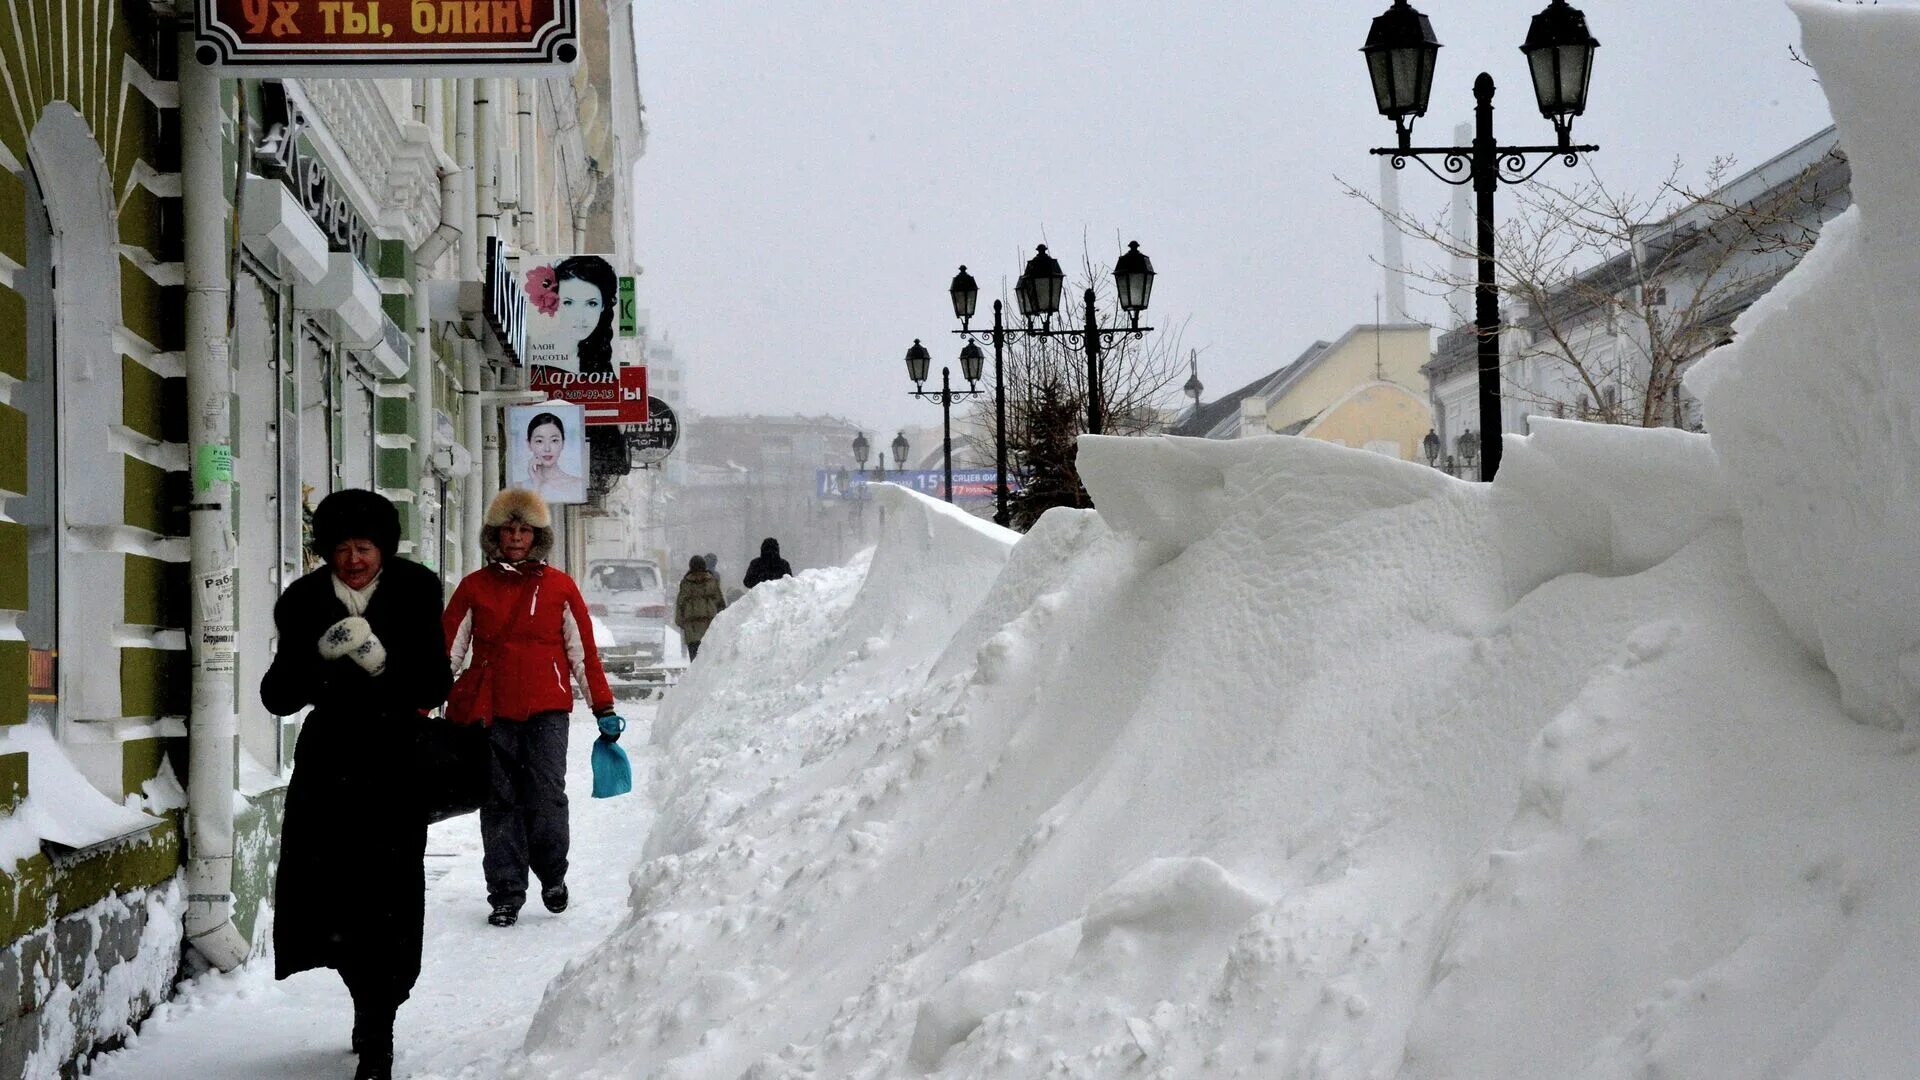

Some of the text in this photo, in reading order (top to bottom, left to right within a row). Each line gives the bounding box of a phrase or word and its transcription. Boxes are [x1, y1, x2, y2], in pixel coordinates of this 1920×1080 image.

[318, 0, 394, 37] ты,
[411, 0, 532, 34] блин!
[531, 365, 615, 388] Ларсон
[620, 387, 641, 400] Ы
